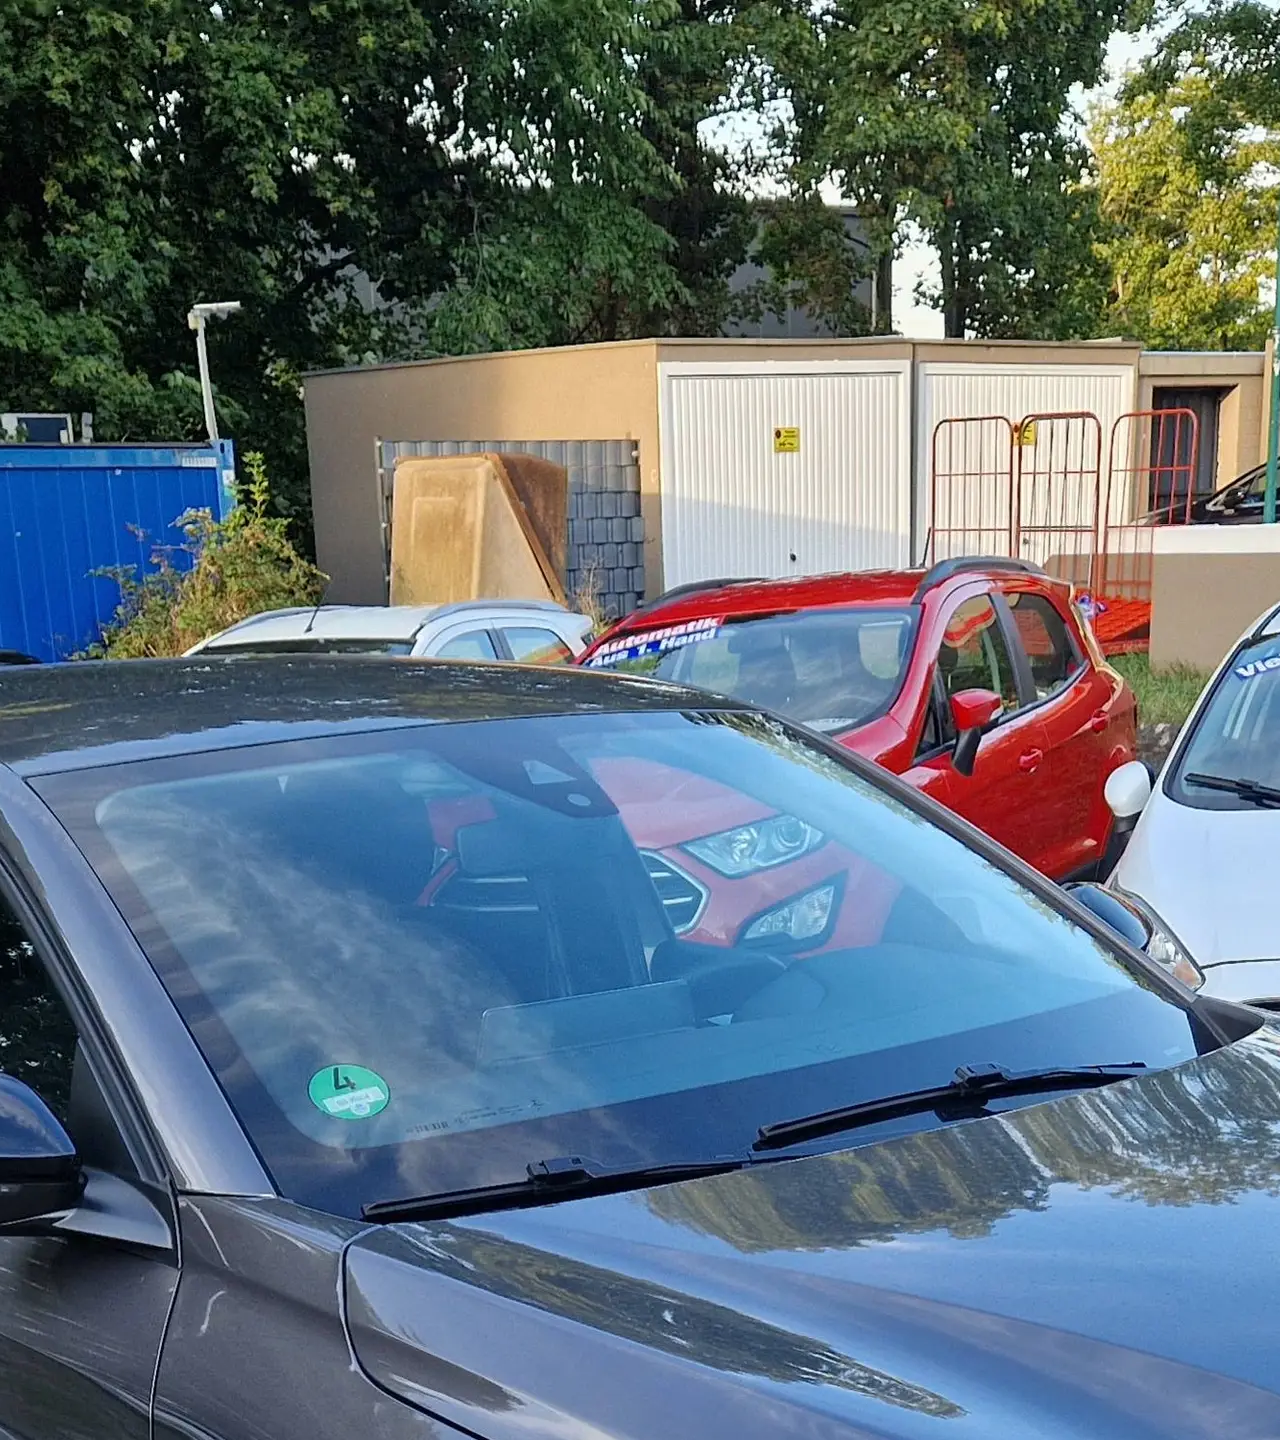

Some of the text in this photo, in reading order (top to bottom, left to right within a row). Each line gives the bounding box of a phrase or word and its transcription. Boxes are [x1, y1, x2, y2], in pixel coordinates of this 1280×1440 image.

[589, 628, 717, 668] Aus 1. Hand
[592, 615, 720, 657] Automatik
[332, 1066, 357, 1090] 4
